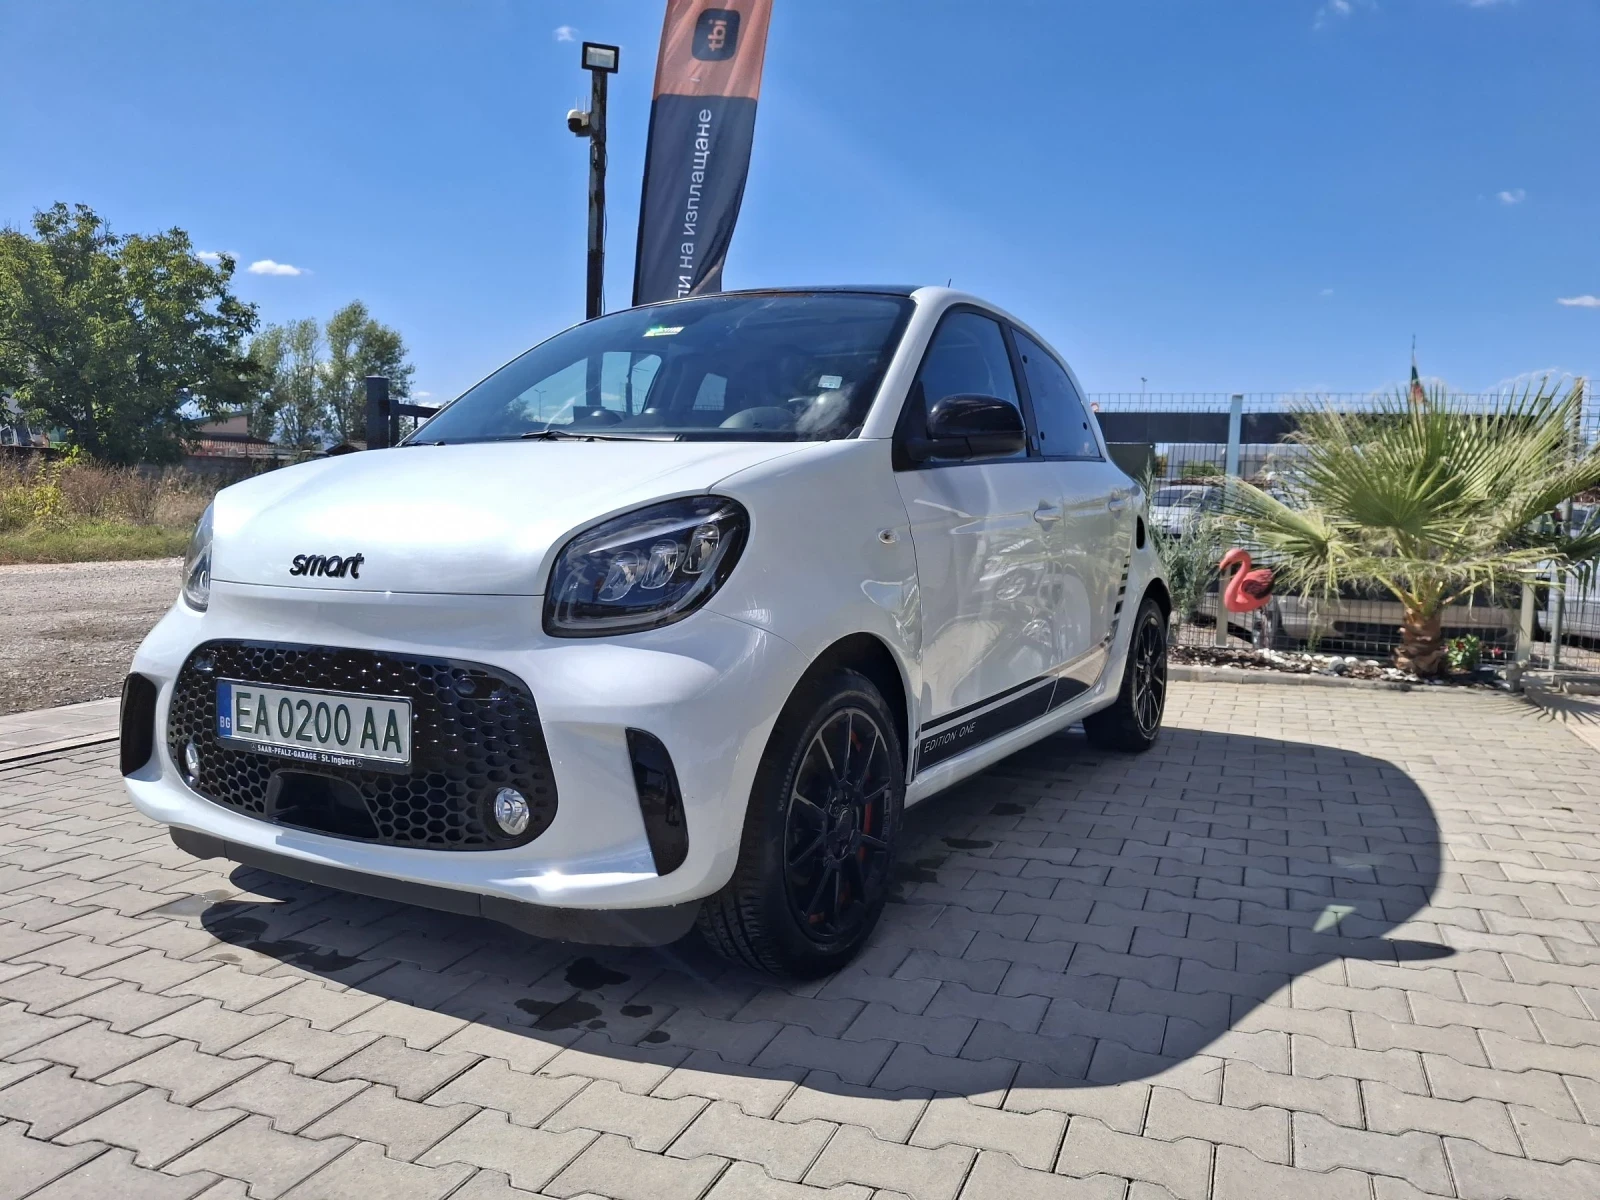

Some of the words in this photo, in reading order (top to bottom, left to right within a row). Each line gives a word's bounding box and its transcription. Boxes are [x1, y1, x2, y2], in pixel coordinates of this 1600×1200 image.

[708, 19, 727, 51] tbi
[683, 109, 712, 236] изплащане
[679, 244, 693, 268] на
[289, 552, 364, 579] smart
[219, 715, 231, 729] BG
[278, 697, 351, 746] 0200
[924, 730, 957, 753] EDITION
[959, 721, 976, 738] ONE
[257, 744, 317, 760] SAAR-PFALZ-GARAGE
[331, 755, 356, 766] Ingbert
